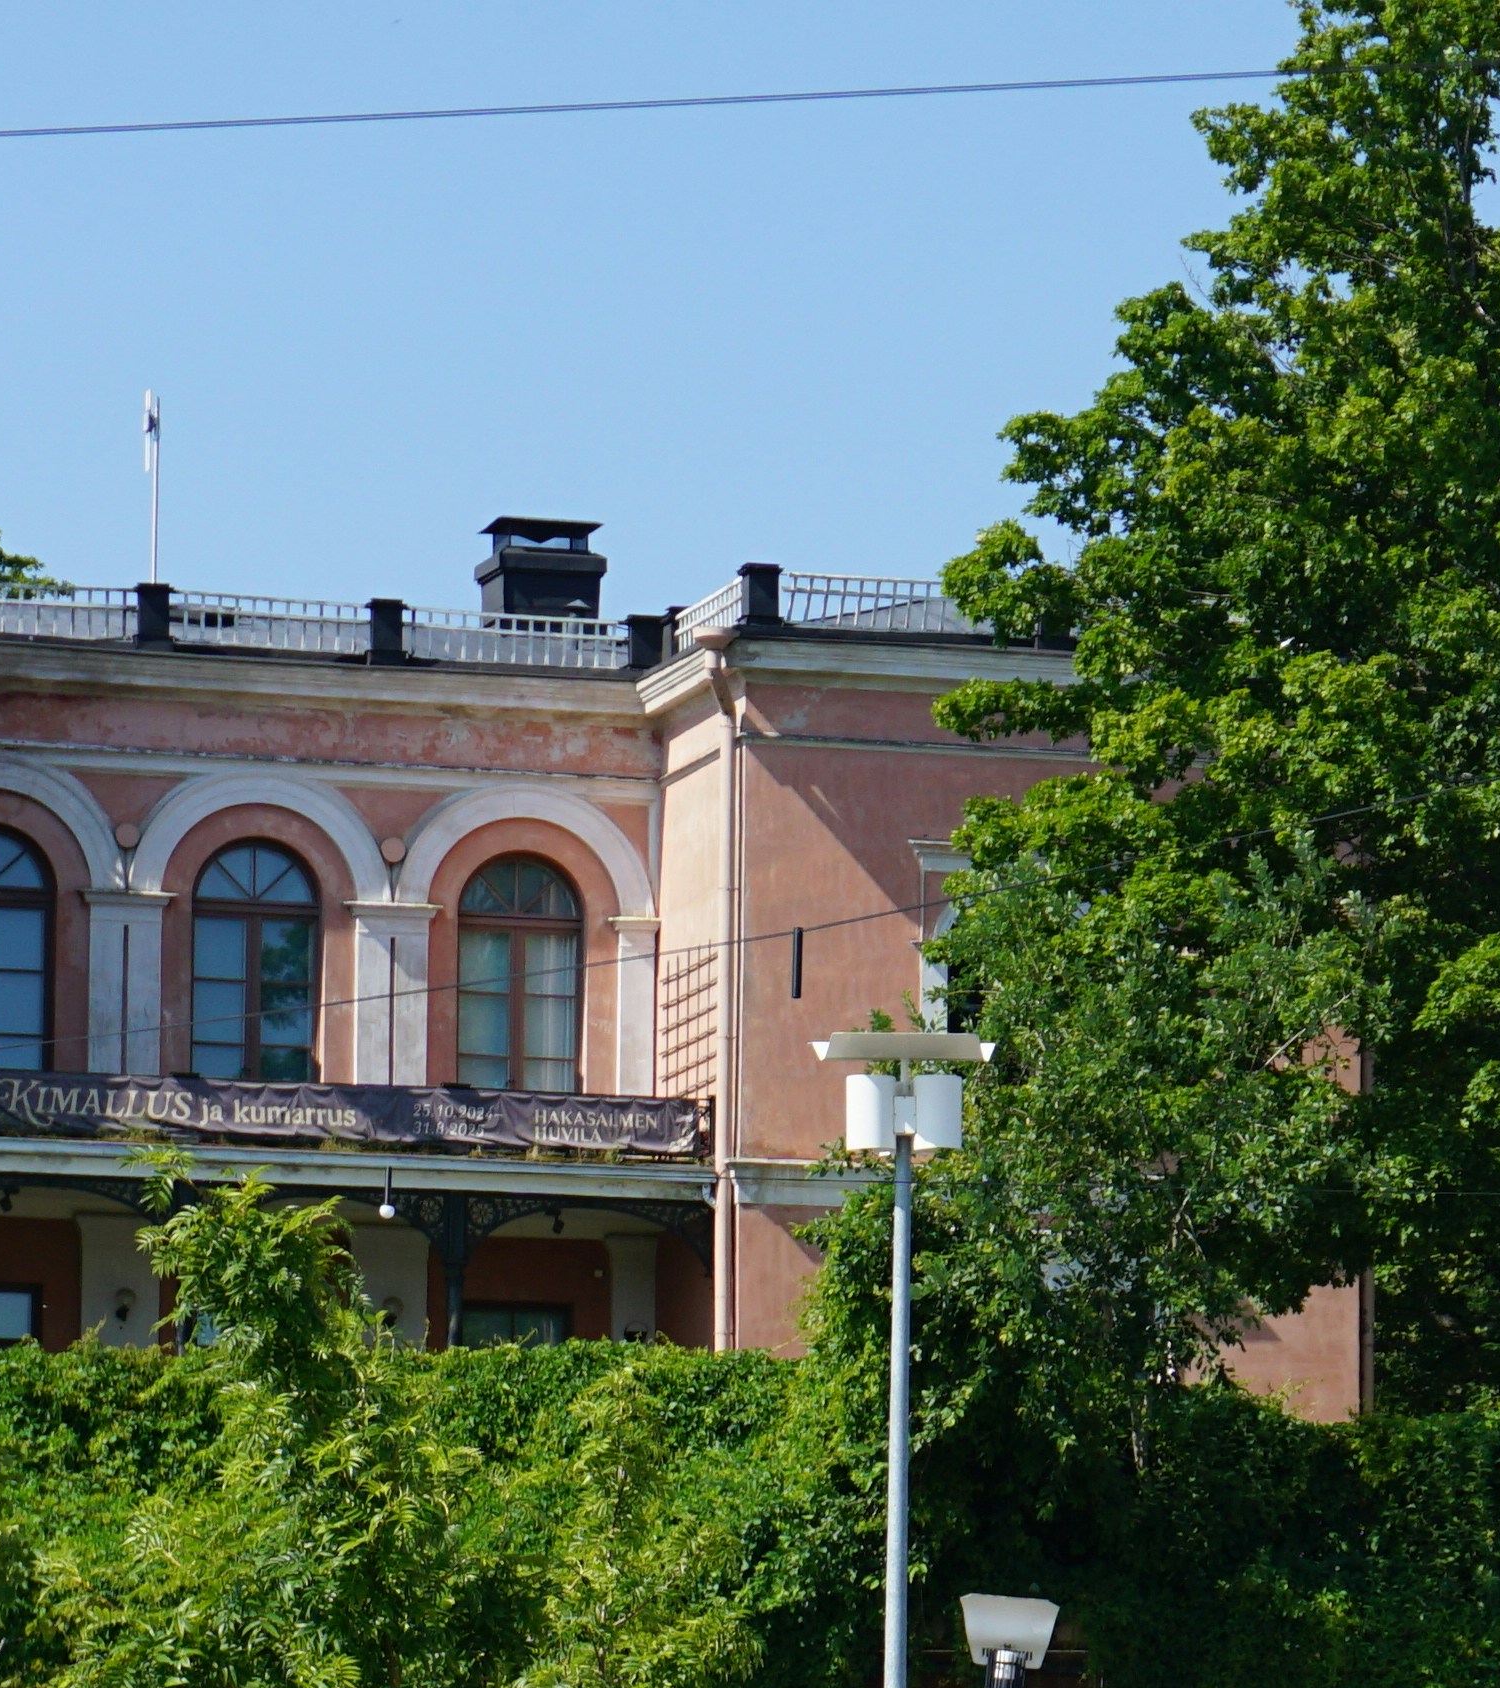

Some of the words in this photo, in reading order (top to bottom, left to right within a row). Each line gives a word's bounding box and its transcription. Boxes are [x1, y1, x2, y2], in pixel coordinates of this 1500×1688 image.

[200, 1098, 223, 1126] ja
[233, 1099, 357, 1127] kumarrus
[534, 1108, 658, 1130] HAKASALMEN
[534, 1126, 602, 1142] HUVILA
